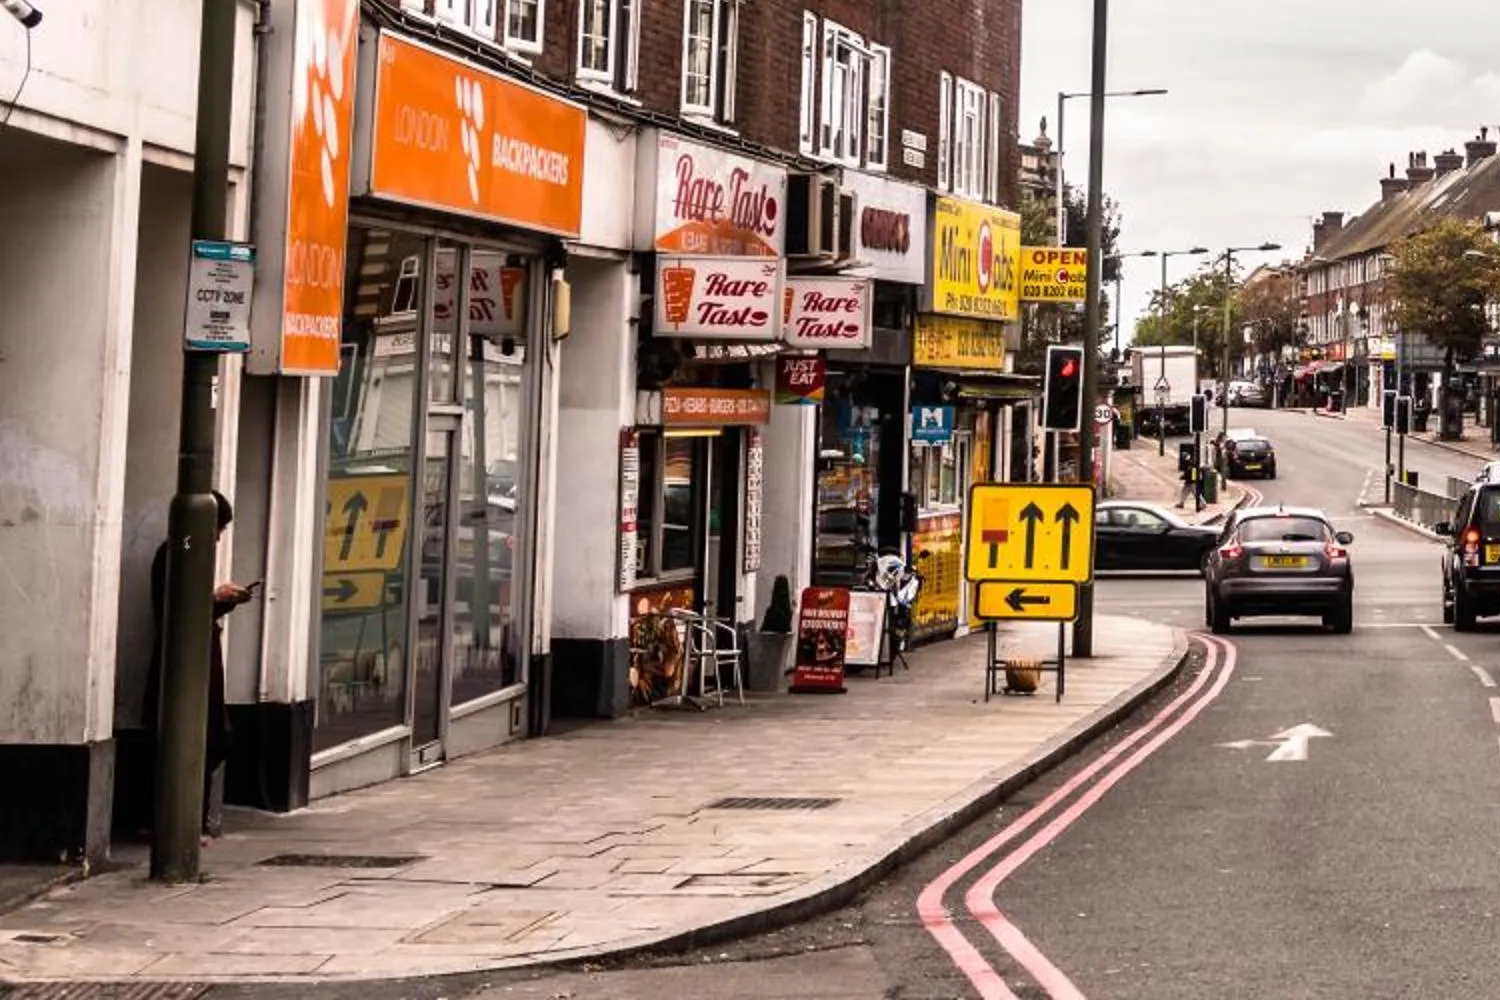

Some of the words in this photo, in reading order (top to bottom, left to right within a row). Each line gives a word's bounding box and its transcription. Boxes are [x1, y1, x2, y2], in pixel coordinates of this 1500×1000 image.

[394, 104, 448, 151] LONDON
[492, 132, 569, 186] BACKPACKERS
[672, 153, 724, 223] Rare
[287, 239, 343, 288] LONDON
[939, 224, 972, 283] Mini
[977, 220, 1013, 294] Cabs
[1032, 250, 1087, 265] OPEN
[705, 273, 769, 297] Rare
[1023, 269, 1052, 282] Mini
[197, 289, 221, 303] CCTV
[223, 291, 244, 305] ZONE
[803, 291, 859, 313] Rare
[285, 312, 338, 339] BACKPACKERS
[784, 360, 817, 373] JUST
[789, 372, 817, 385] EAT
[1095, 409, 1110, 419] 30
